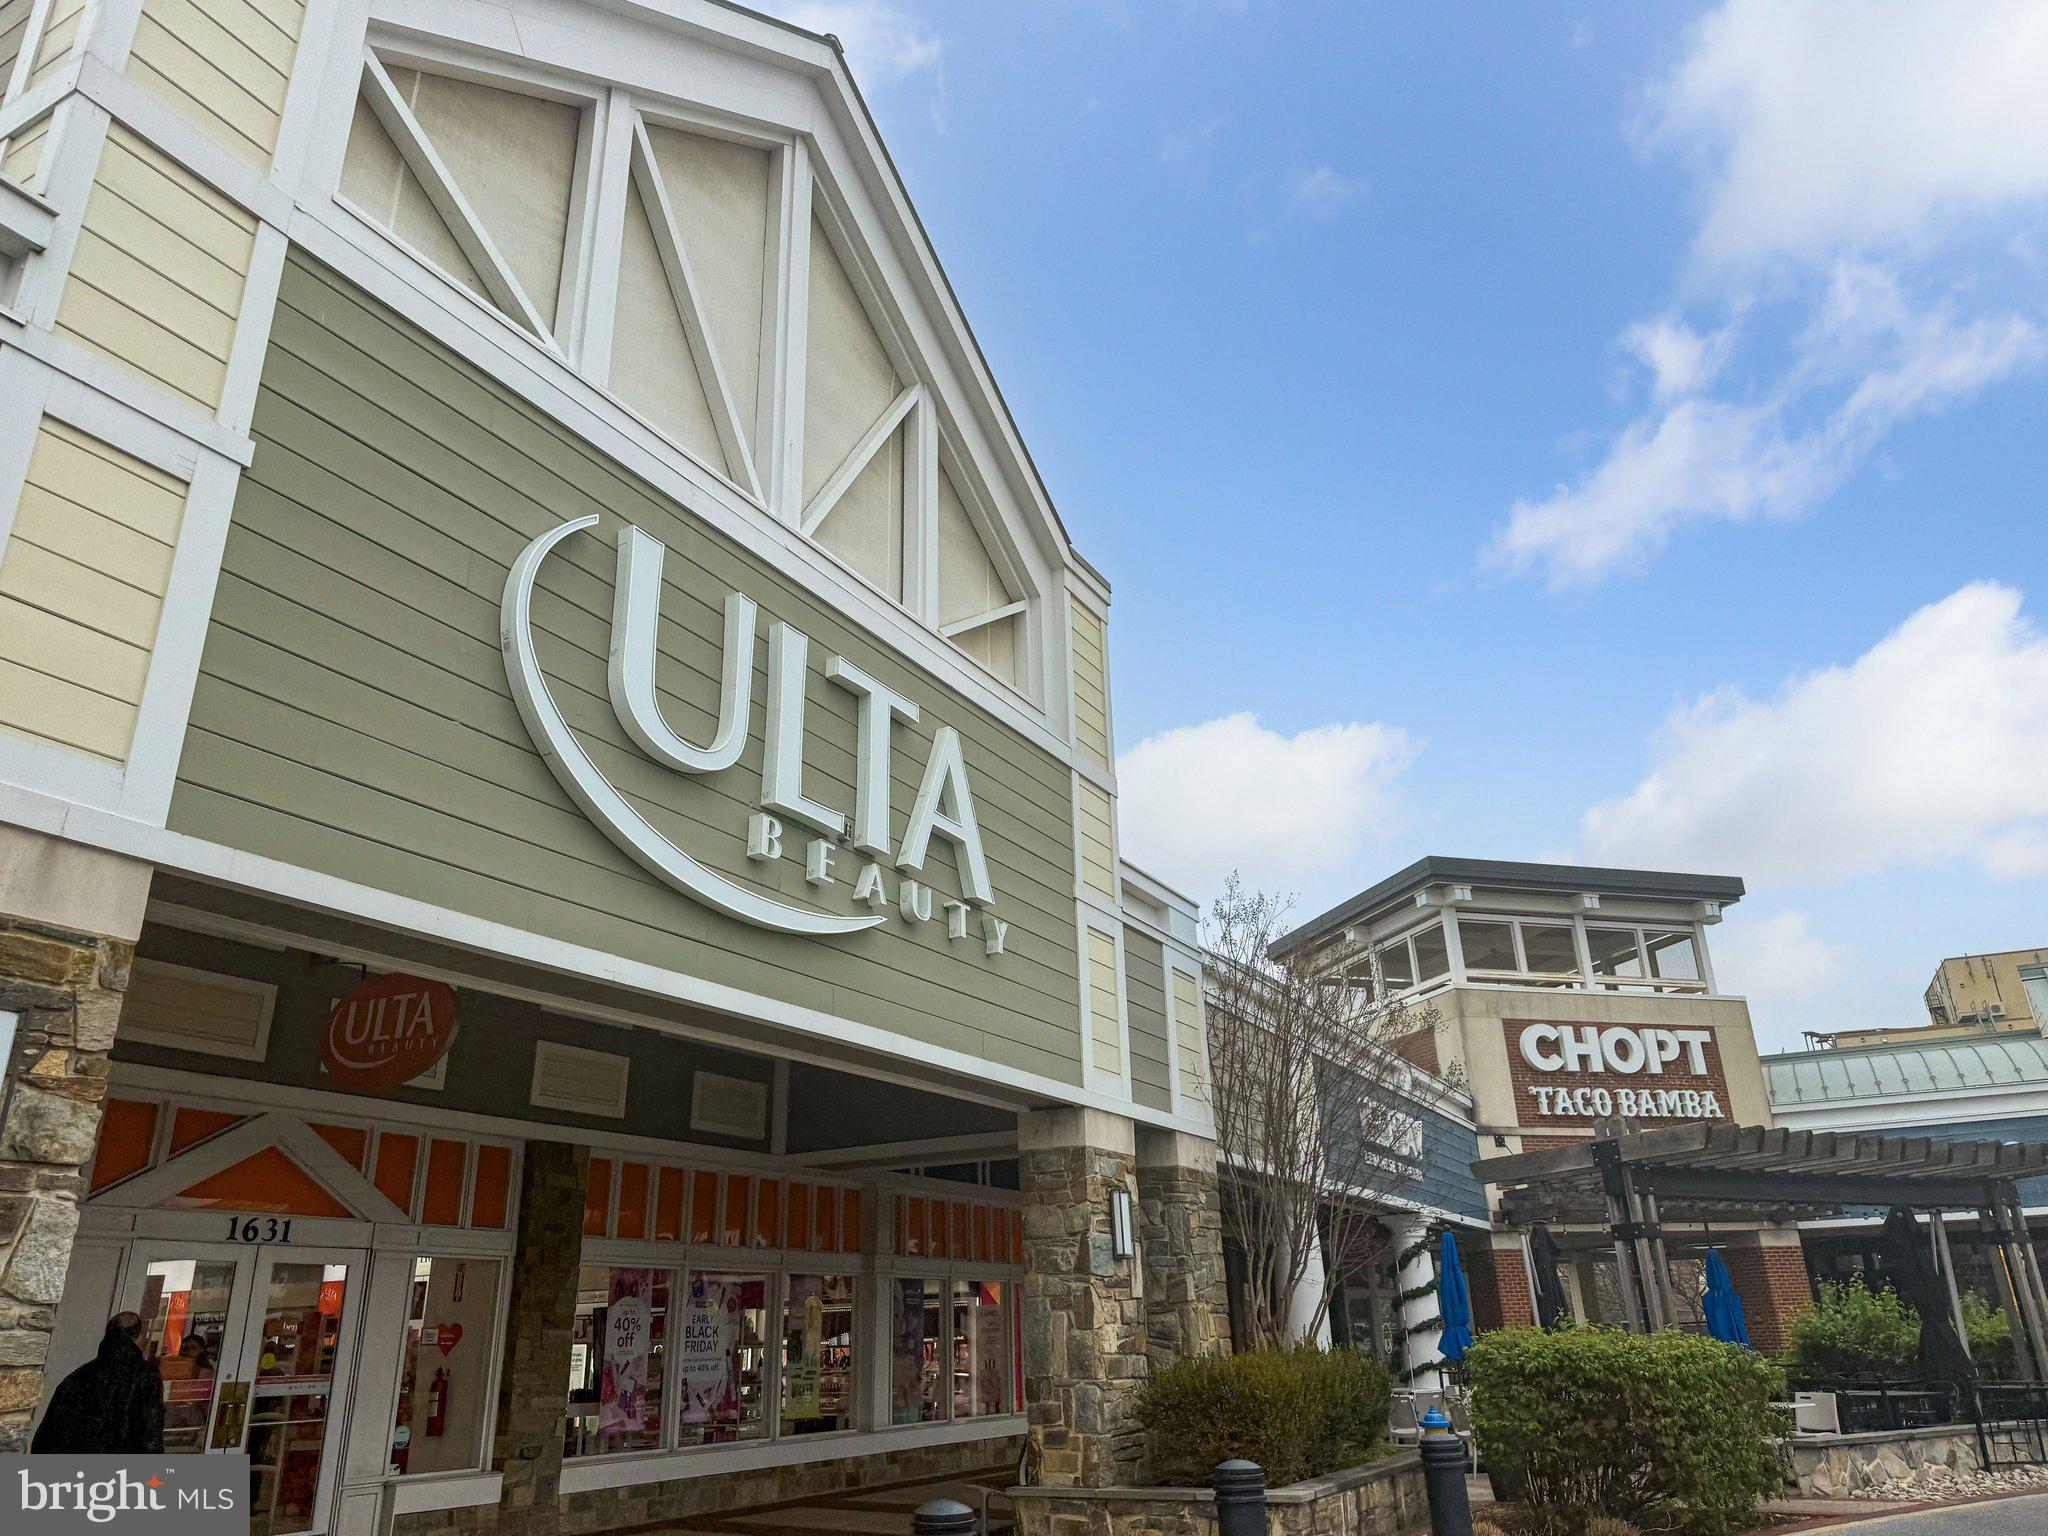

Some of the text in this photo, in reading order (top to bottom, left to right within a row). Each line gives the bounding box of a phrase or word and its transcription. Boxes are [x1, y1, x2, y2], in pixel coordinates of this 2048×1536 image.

[607, 523, 995, 905] ULTA
[746, 812, 1009, 956] BEAUTY
[345, 990, 434, 1045] ULTA
[368, 1036, 438, 1056] BEAUTY
[1520, 1023, 1711, 1076] CHOPT
[1528, 1085, 1724, 1119] TACO BAMBA
[226, 1216, 291, 1242] 1631
[614, 1317, 641, 1332] 40%
[692, 1314, 714, 1324] EARLY
[617, 1332, 635, 1347] off
[685, 1325, 719, 1338] BLACK
[684, 1340, 719, 1353] FRIDAY
[697, 1363, 710, 1371] 40%
